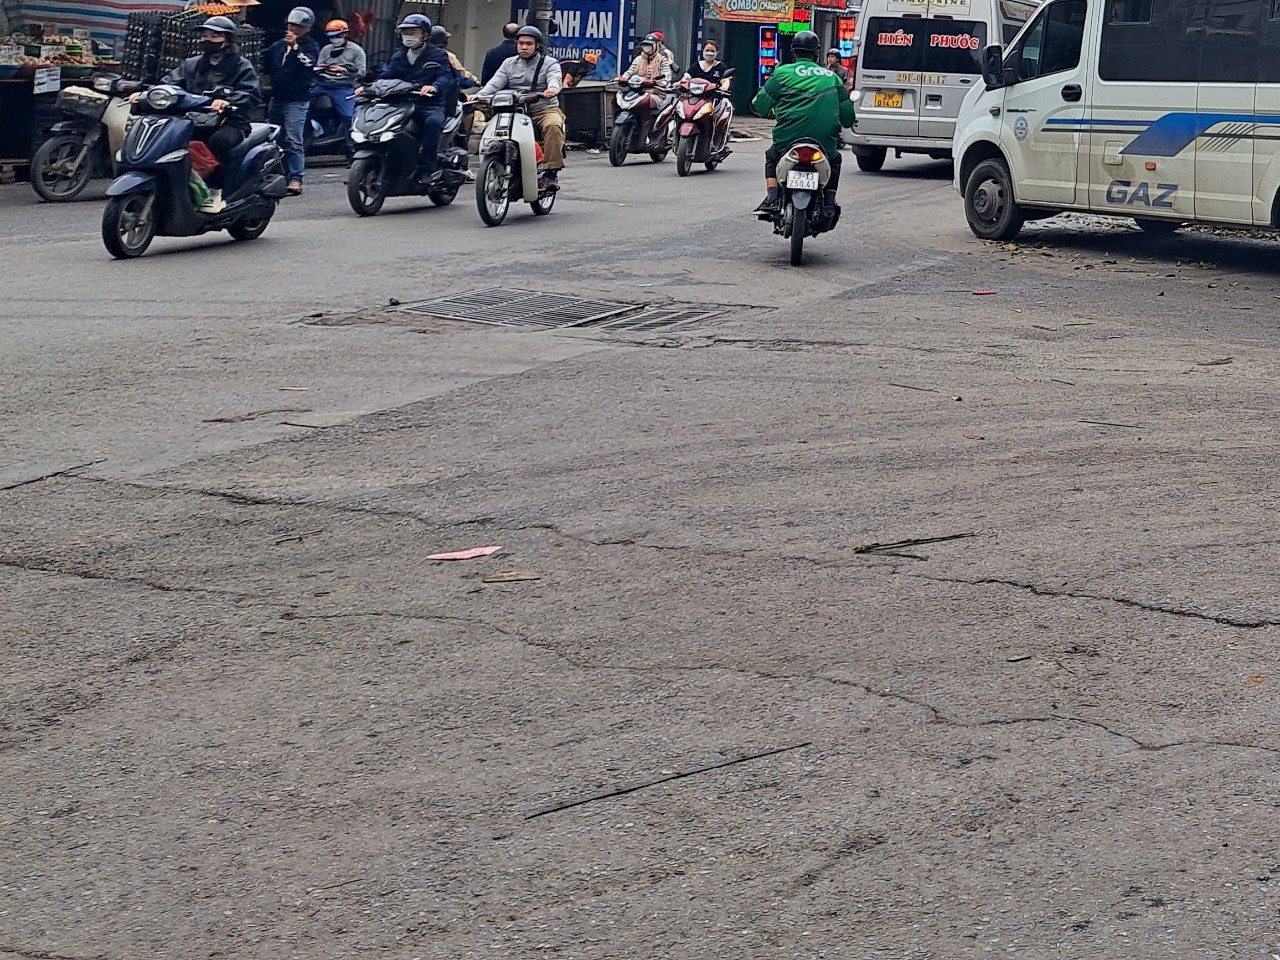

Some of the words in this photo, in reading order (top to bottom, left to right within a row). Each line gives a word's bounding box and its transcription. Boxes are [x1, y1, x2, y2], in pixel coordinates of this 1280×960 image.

[517, 8, 581, 39] KNH
[585, 11, 613, 39] AN
[795, 65, 834, 77] Grab
[1106, 181, 1178, 208] GAZ
